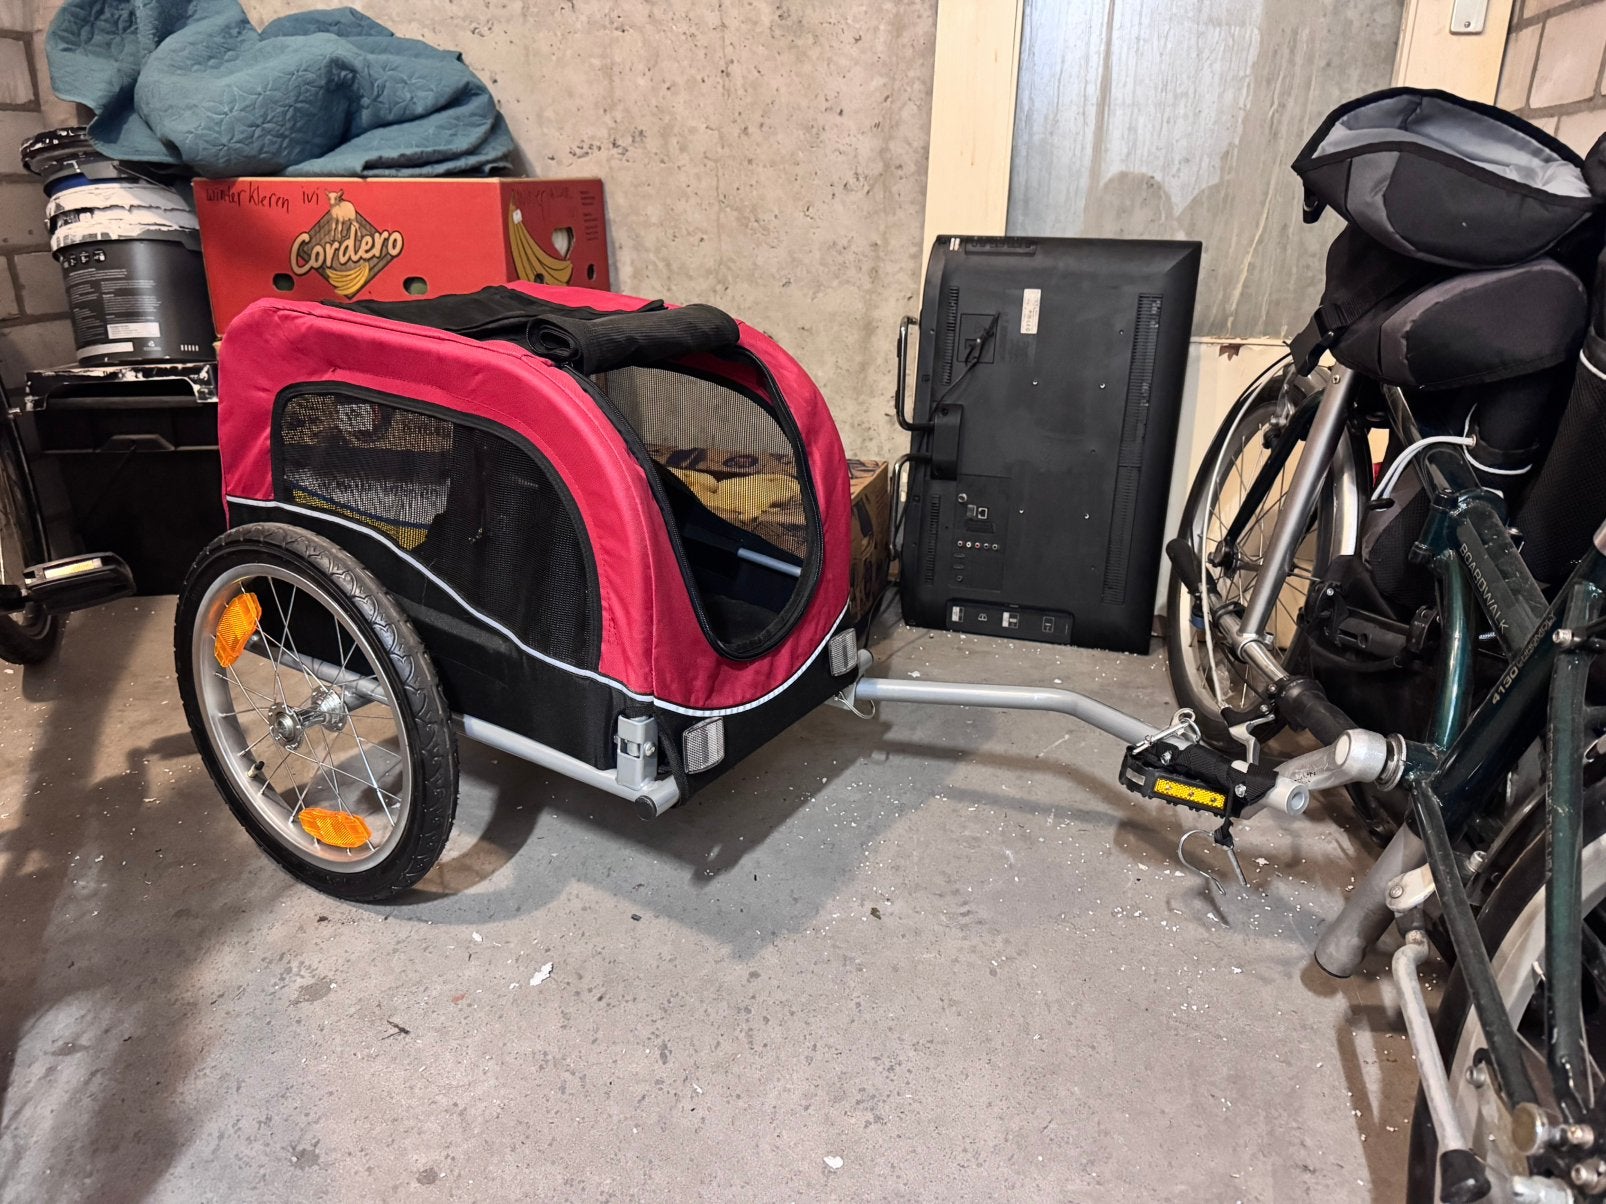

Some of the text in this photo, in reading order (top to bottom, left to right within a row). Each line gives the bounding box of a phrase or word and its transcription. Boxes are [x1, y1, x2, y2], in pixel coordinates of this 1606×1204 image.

[290, 222, 404, 276] Cordero
[1460, 543, 1509, 634] BOARDWALK
[1492, 666, 1519, 704] 4130
